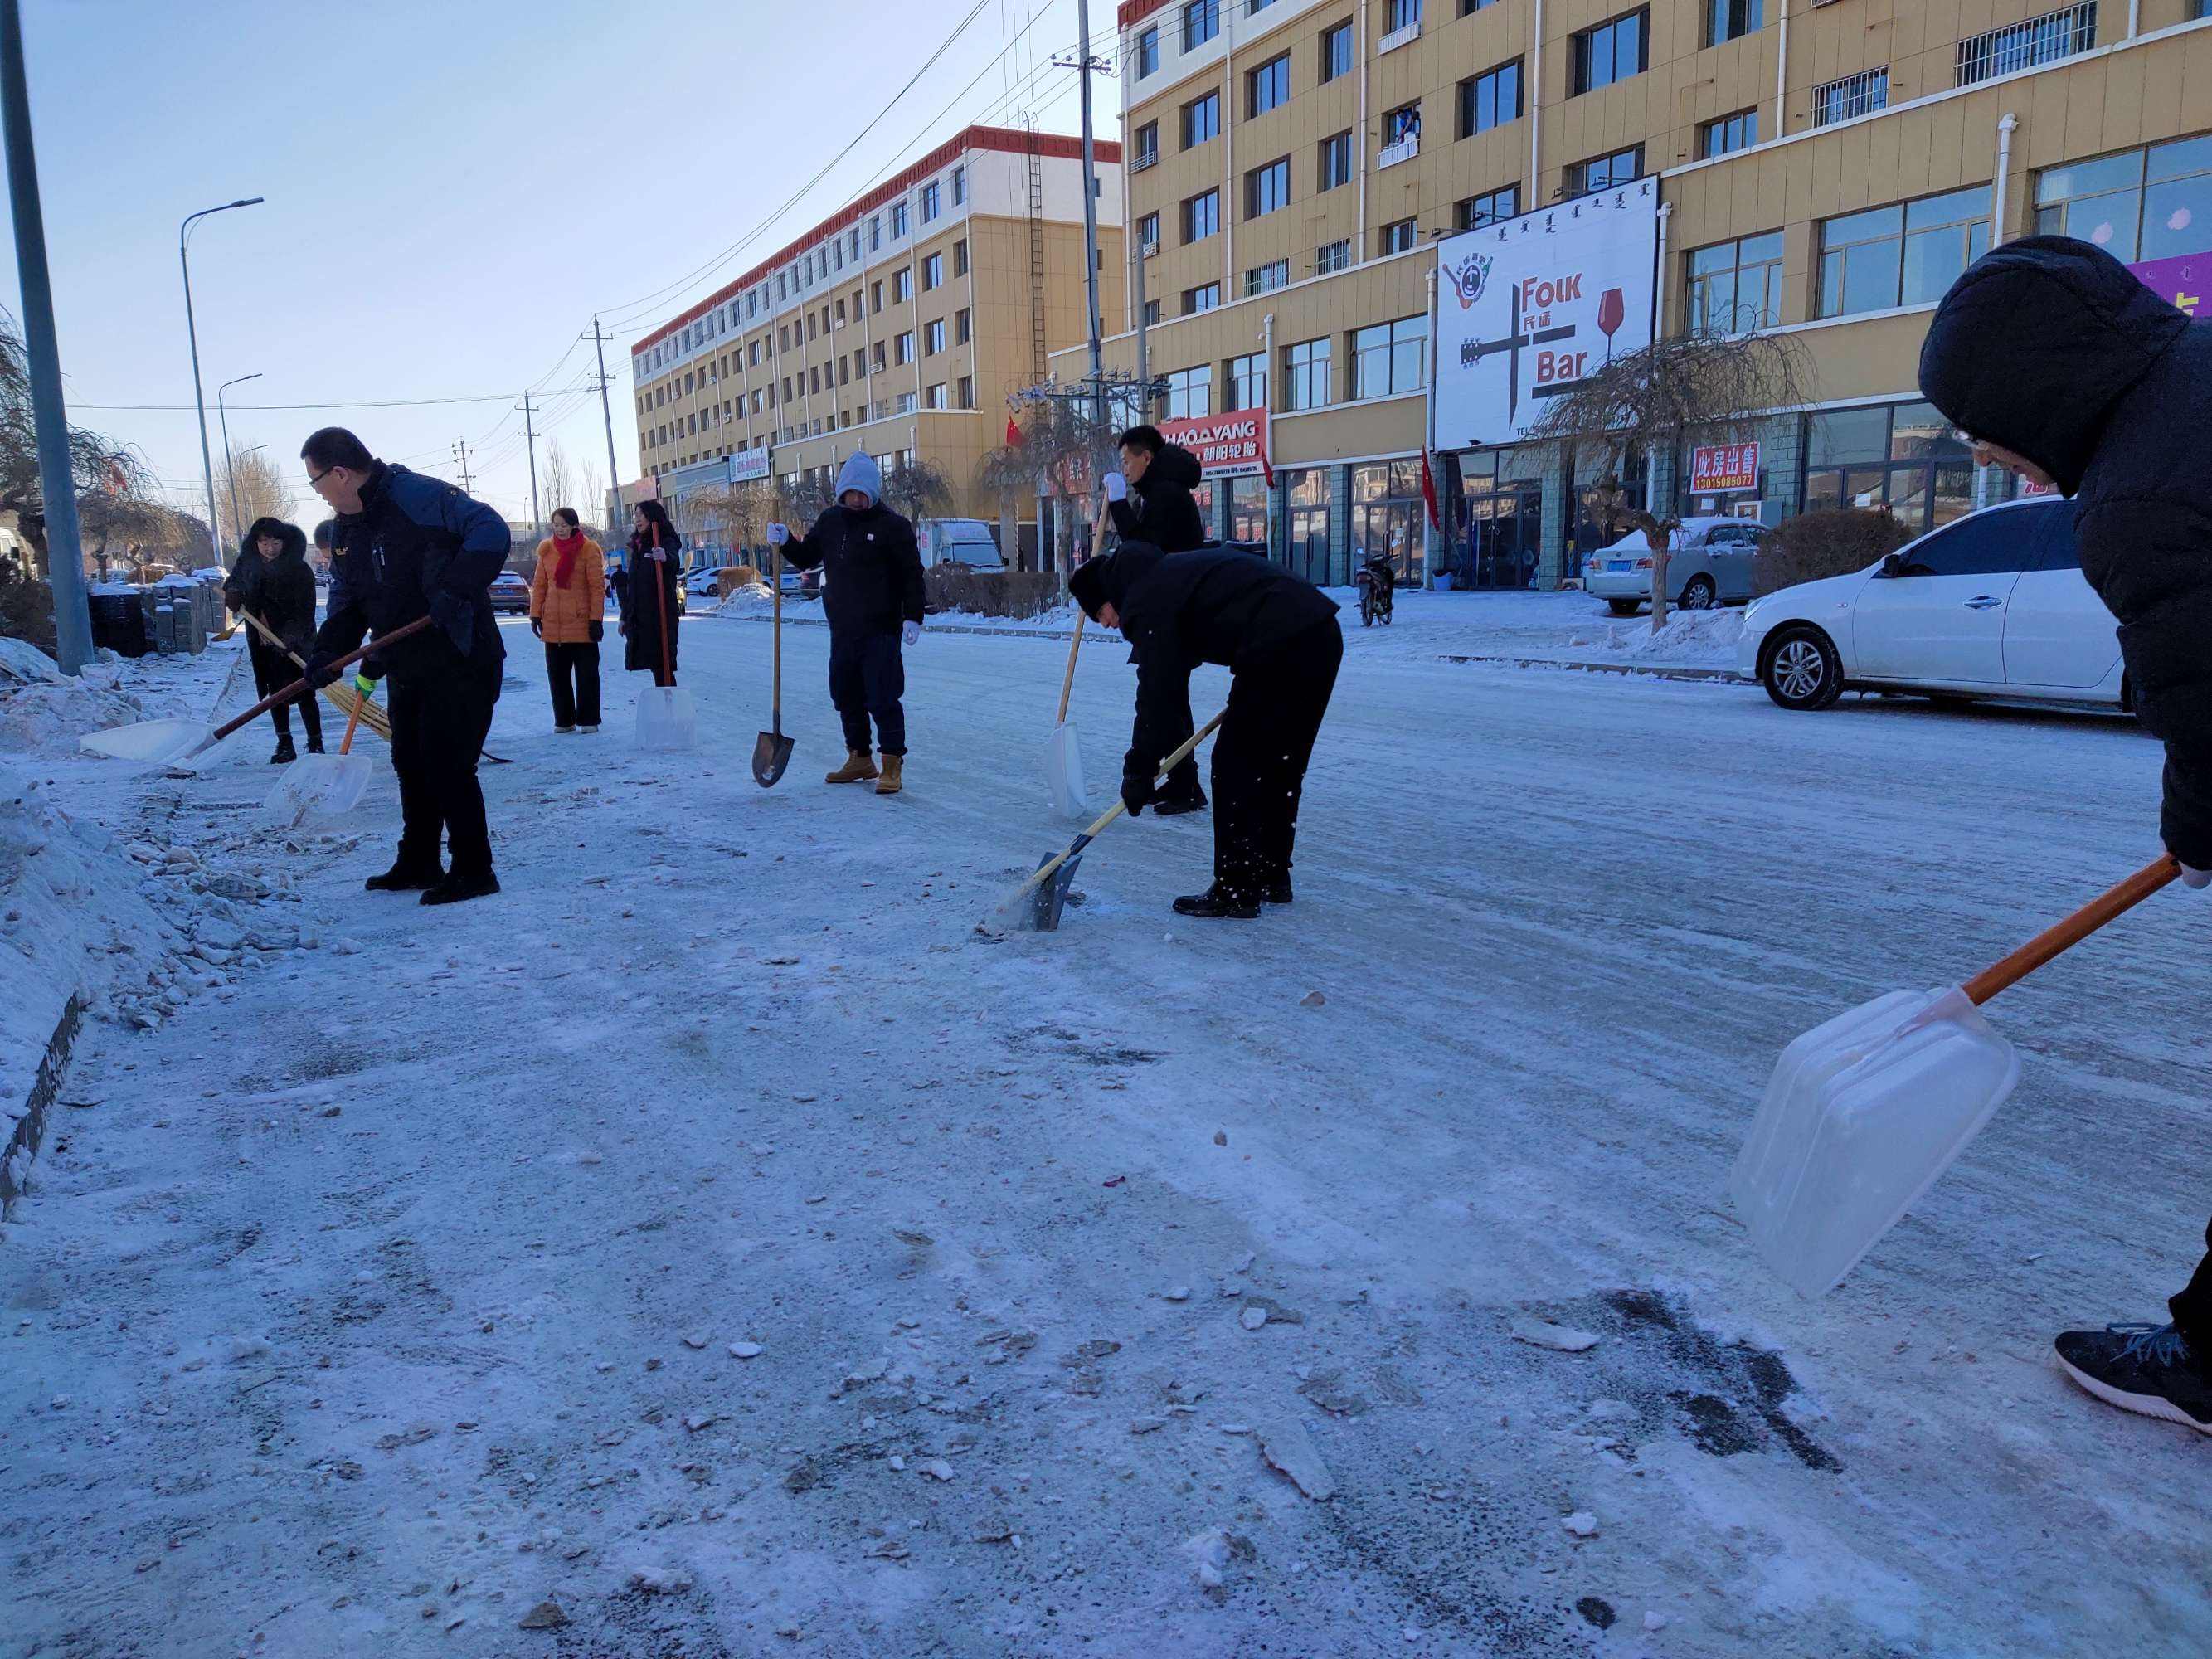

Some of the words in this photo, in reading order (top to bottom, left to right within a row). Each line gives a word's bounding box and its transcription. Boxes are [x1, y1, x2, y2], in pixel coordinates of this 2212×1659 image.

[1523, 311, 1552, 332] 民谣
[1537, 350, 1587, 383] Bar
[1203, 440, 1257, 462] 朝阳轮胎
[1697, 445, 1755, 478] 此房出售
